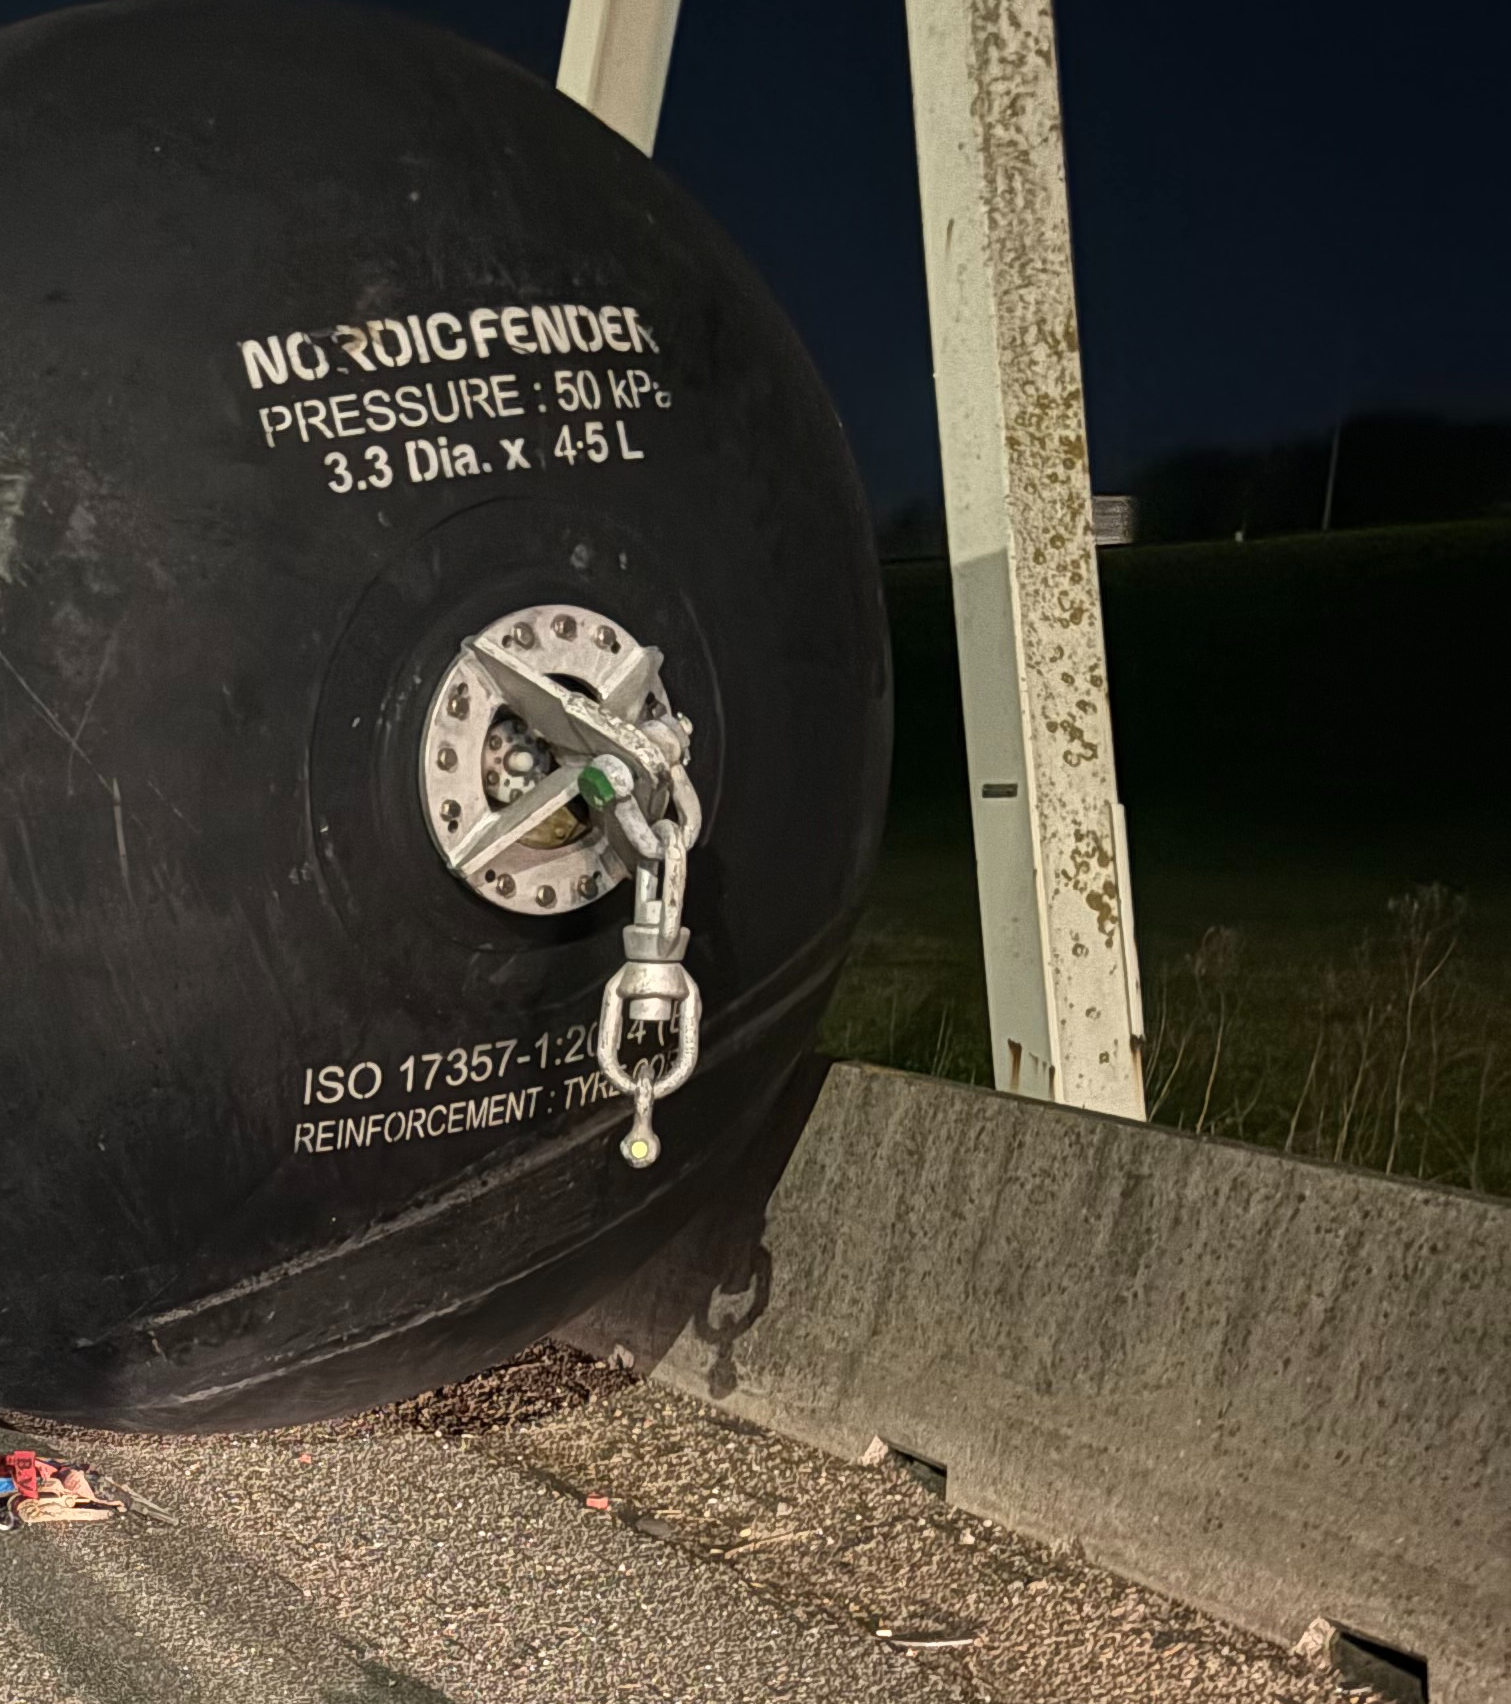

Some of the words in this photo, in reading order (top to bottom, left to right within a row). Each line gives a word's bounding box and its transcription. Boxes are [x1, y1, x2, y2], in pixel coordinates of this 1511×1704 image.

[259, 373, 526, 448] PRESSURE
[554, 370, 601, 412] 50
[323, 445, 393, 494] 3.3
[405, 436, 493, 483] Dia.
[499, 436, 532, 471] x
[615, 419, 645, 460] L
[302, 1061, 383, 1105] ISO
[293, 1086, 544, 1154] REINFORCEMENT
